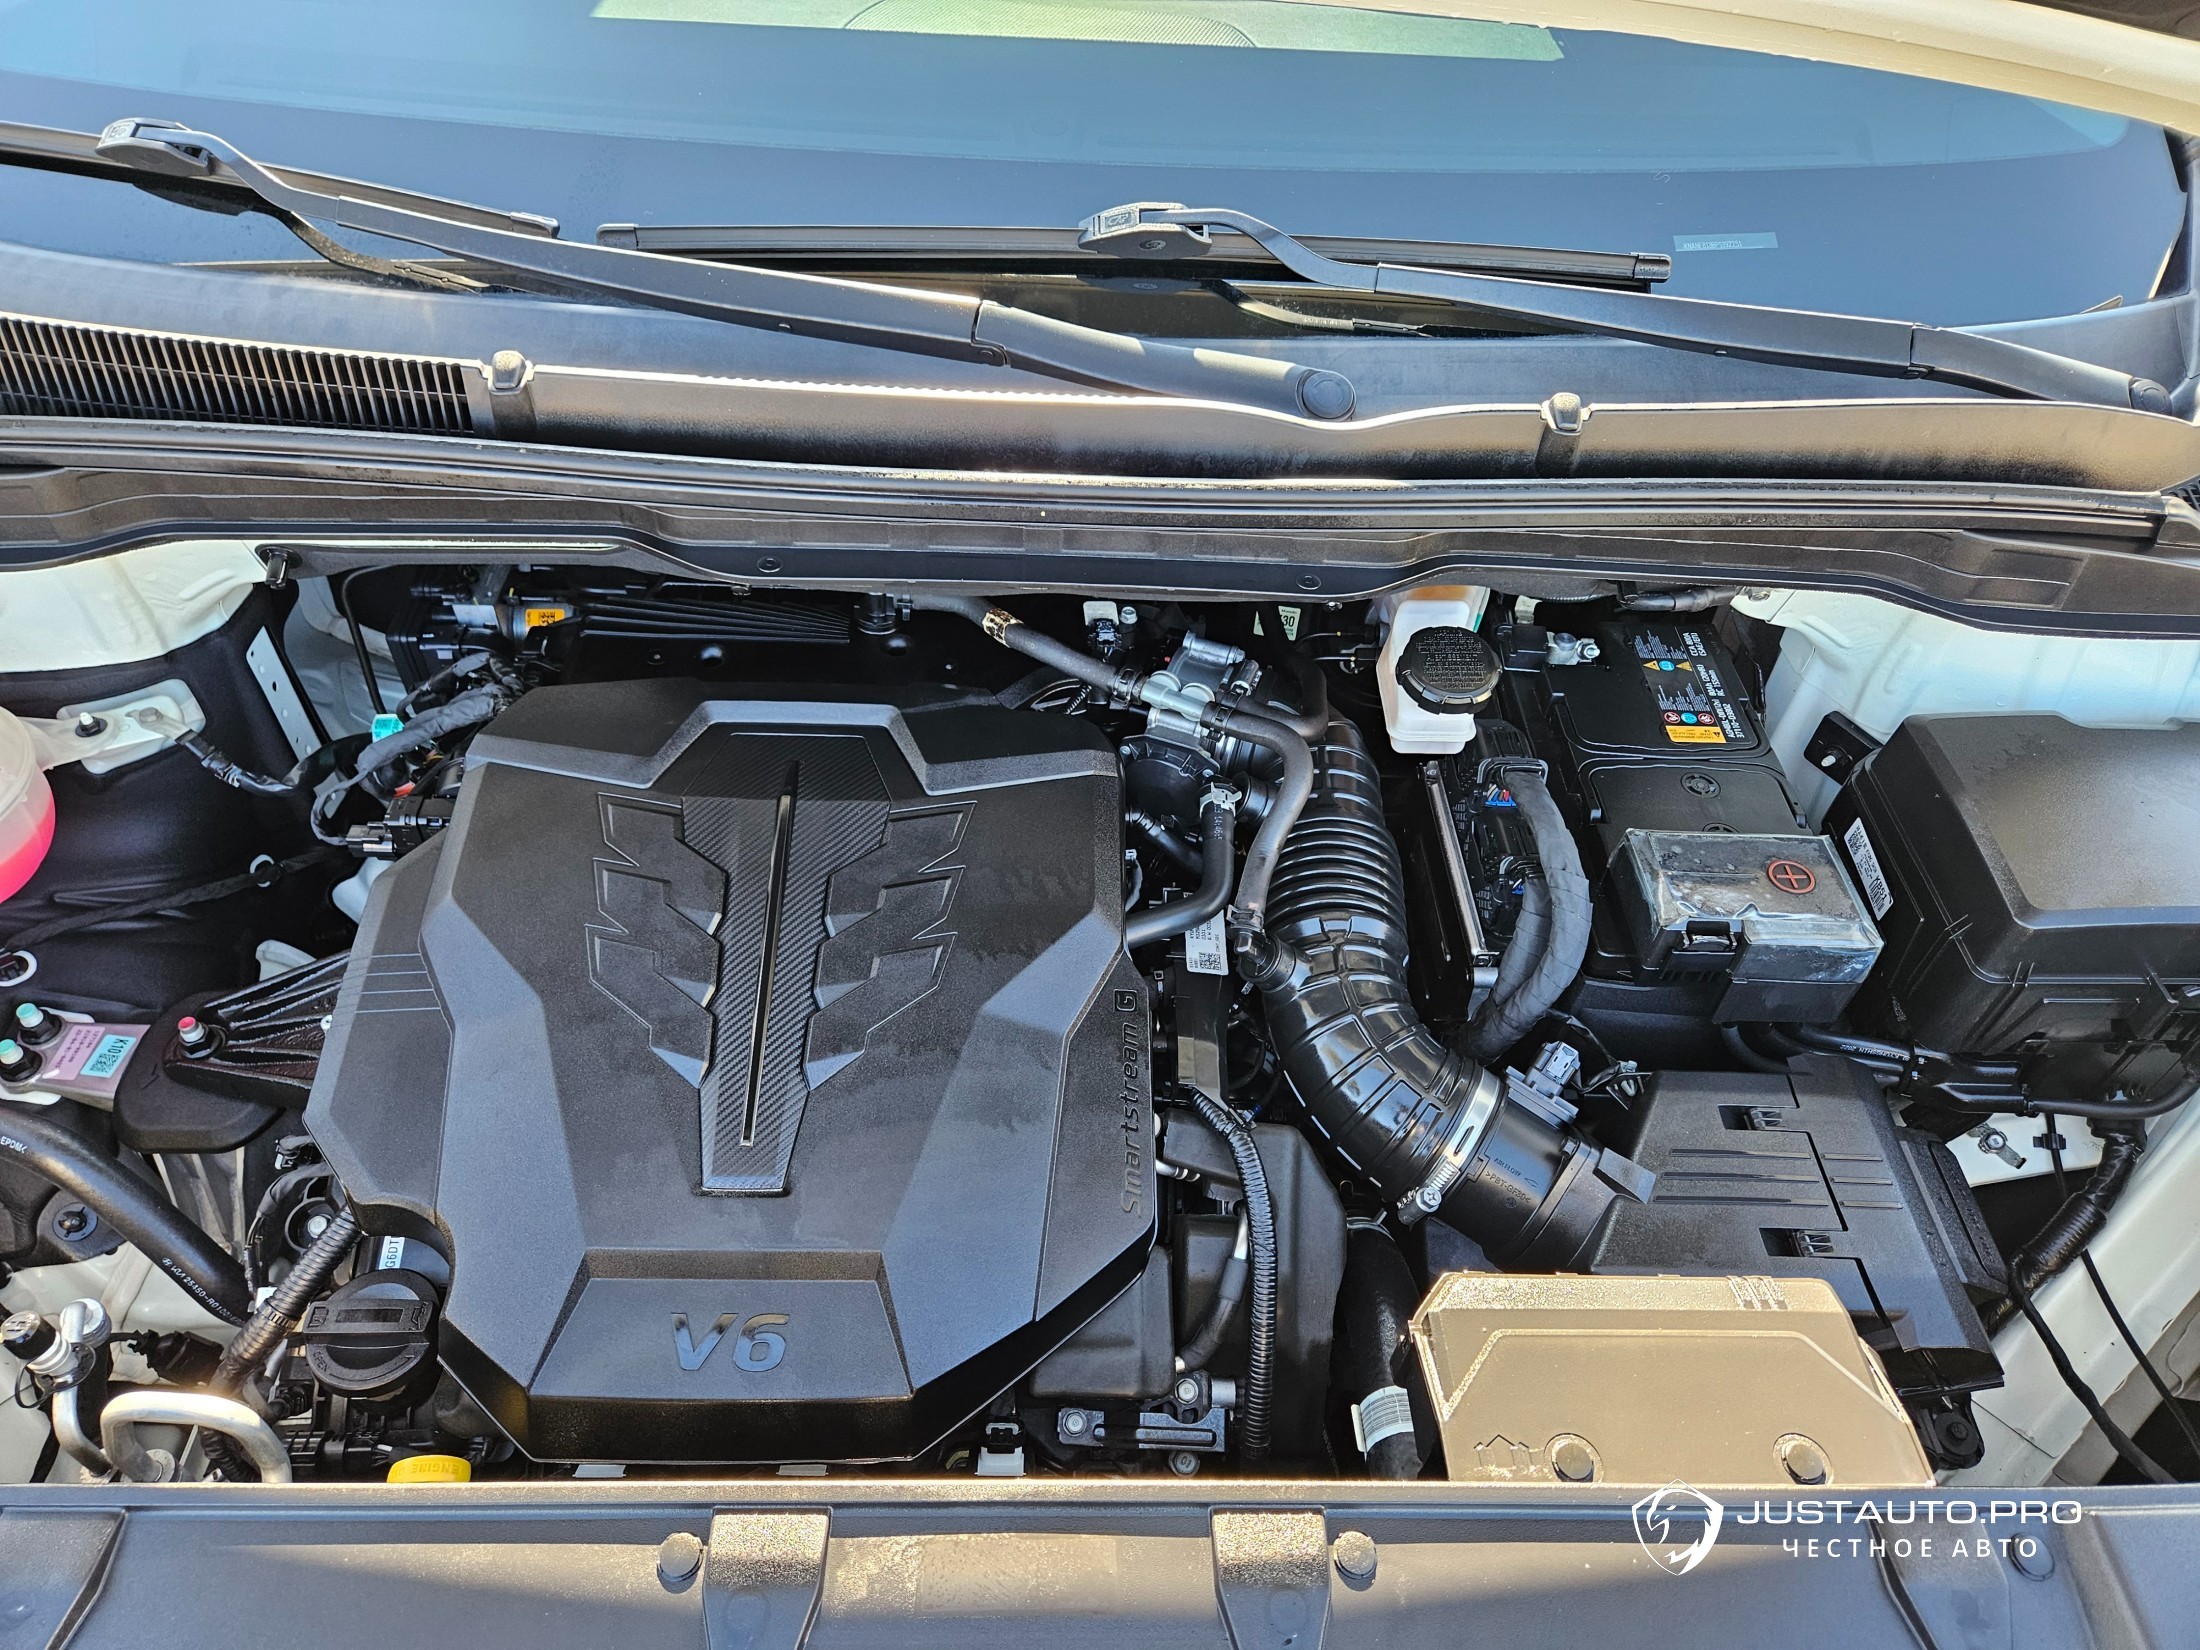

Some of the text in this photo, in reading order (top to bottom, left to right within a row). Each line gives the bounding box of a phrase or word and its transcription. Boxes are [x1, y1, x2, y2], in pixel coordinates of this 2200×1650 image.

[1874, 875, 1888, 901] KB51
[108, 1038, 129, 1054] K10
[1119, 1022, 1142, 1219] Smartstream
[384, 1239, 400, 1268] G6DT
[670, 1312, 790, 1373] V6
[312, 1350, 329, 1373] OPEN
[411, 1462, 461, 1476] ENGINE
